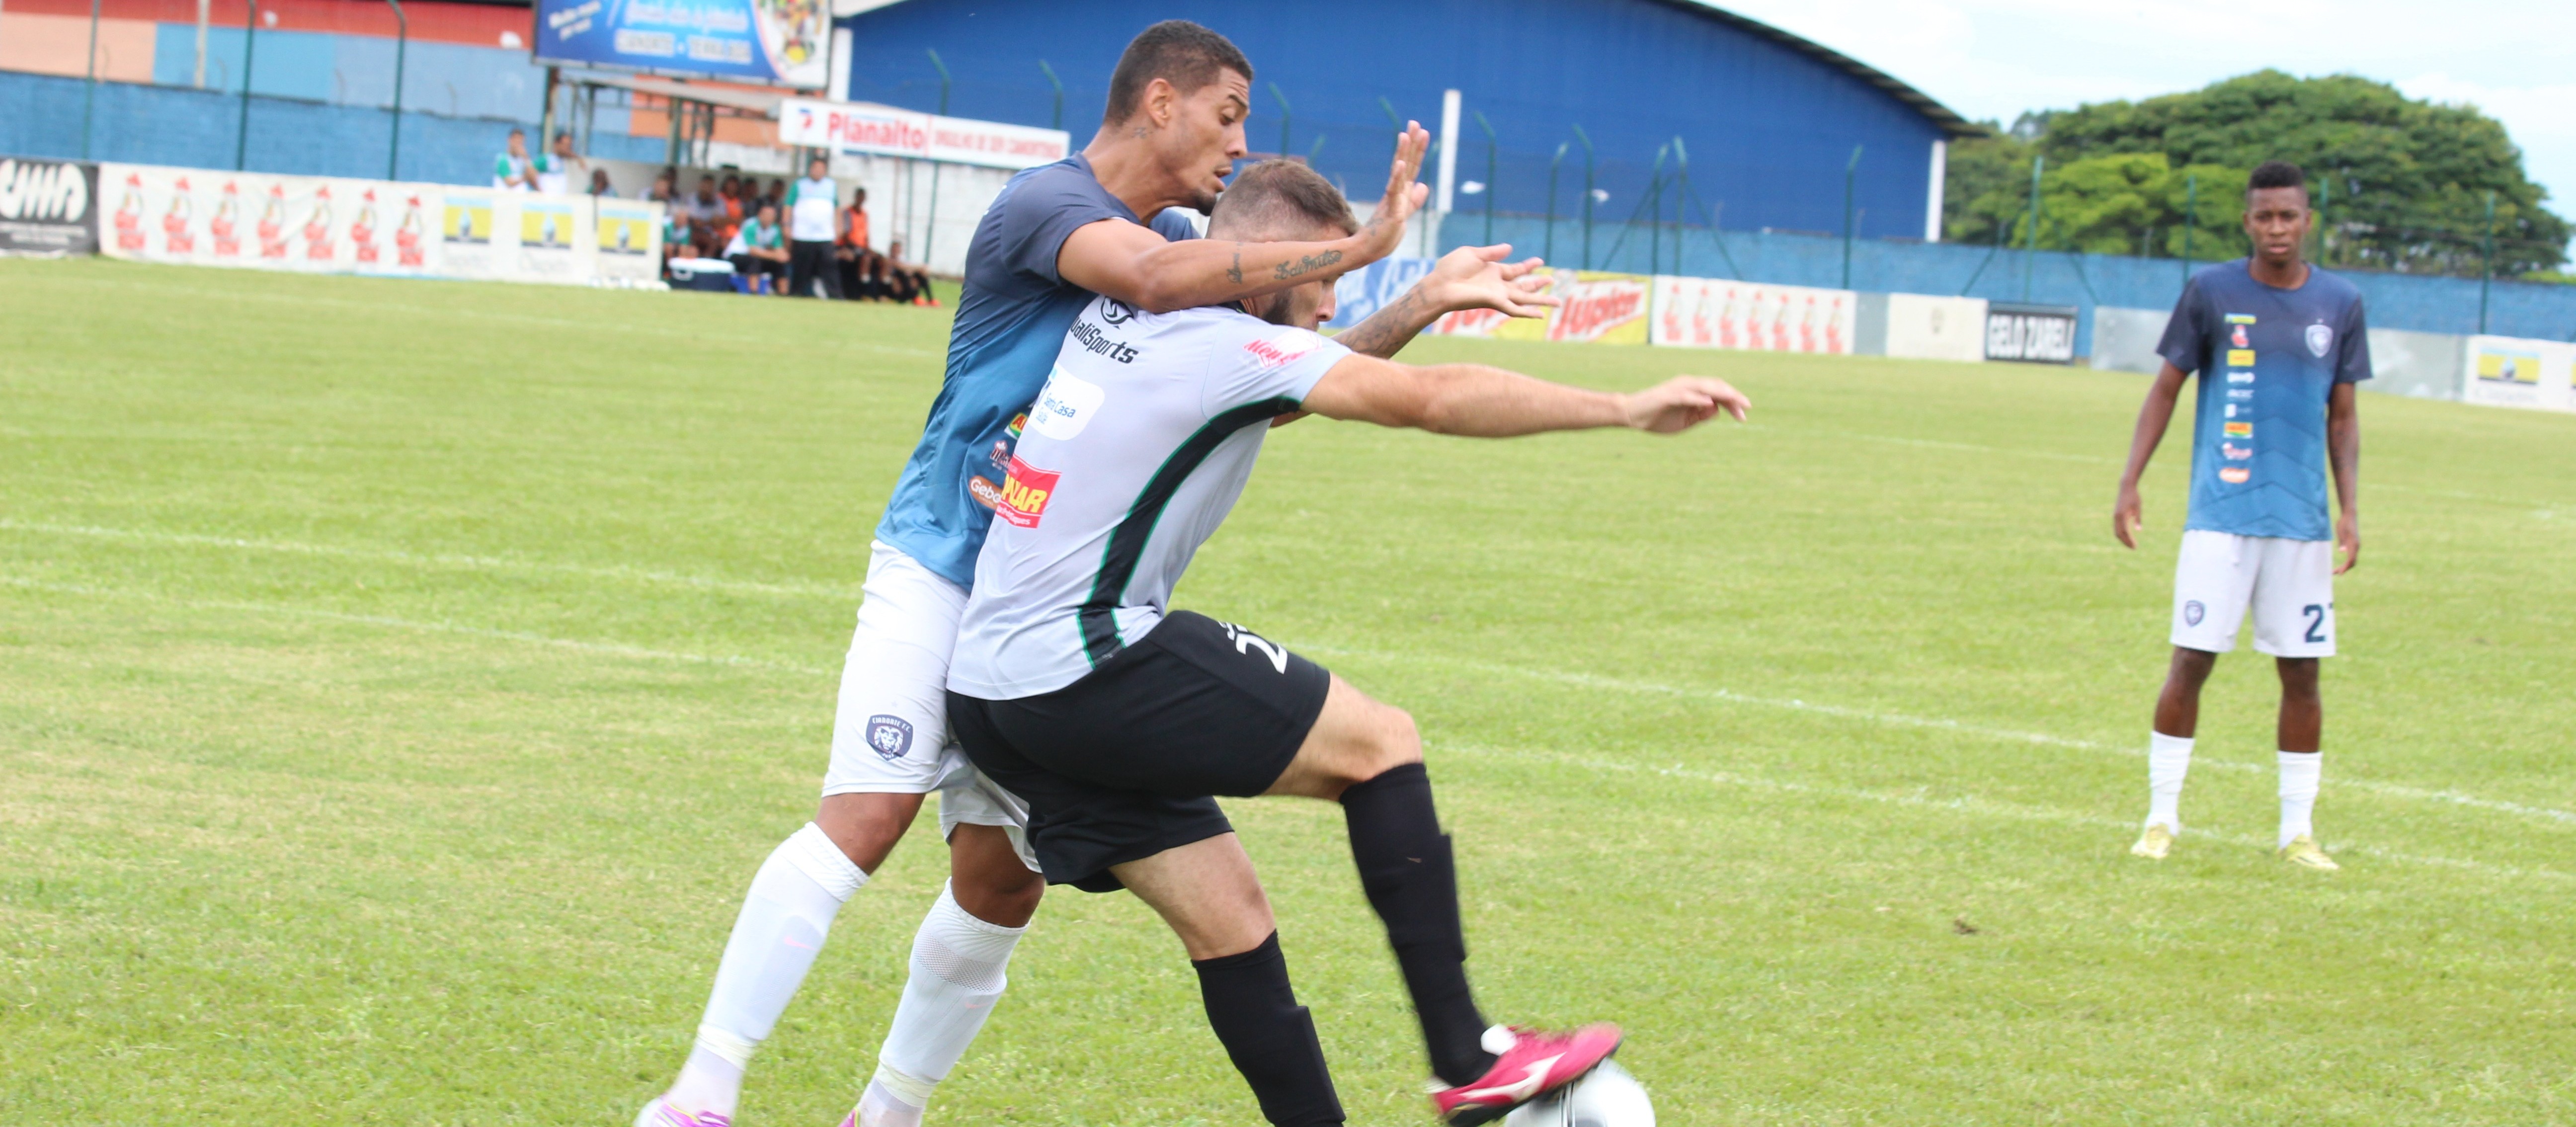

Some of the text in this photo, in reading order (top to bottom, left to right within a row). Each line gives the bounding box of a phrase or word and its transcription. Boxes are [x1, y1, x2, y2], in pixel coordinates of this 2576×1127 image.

[827, 112, 926, 149] Planalto
[1988, 314, 2024, 360] GELO
[1054, 401, 1076, 418] Casa
[2303, 603, 2334, 643] 2
